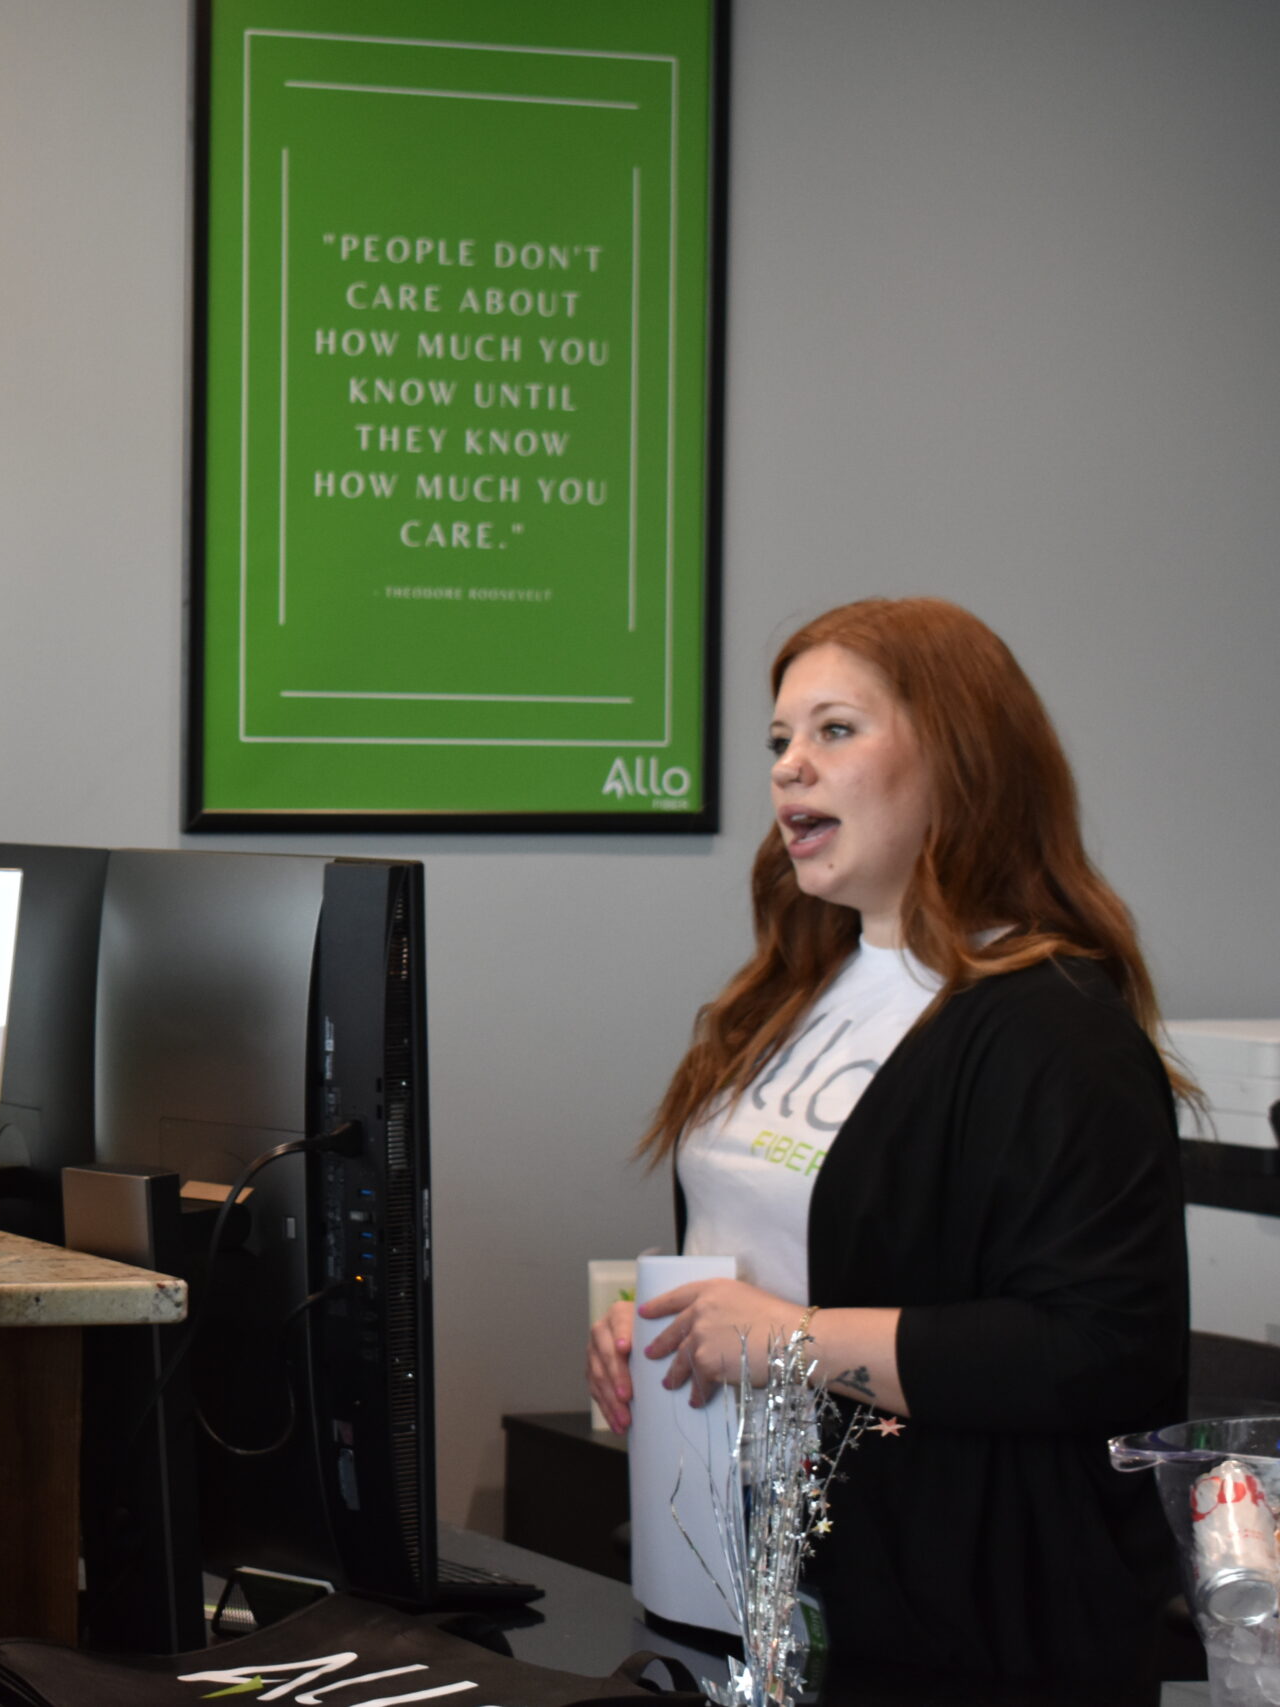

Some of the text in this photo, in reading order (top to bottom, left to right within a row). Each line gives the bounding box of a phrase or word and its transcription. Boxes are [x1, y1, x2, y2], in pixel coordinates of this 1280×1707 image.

[322, 232, 602, 273] "PEOPLE DON'T
[345, 281, 579, 318] CARE ABOUT
[314, 327, 608, 367] HOW MUCH YOU
[348, 376, 577, 412] KNOW UNTIL
[354, 423, 569, 457] THEY KNOW
[313, 470, 607, 506] HOW MUCH YOU
[399, 519, 524, 550] CARE."
[601, 756, 691, 801] Allo
[748, 1013, 881, 1132] llo
[177, 1651, 503, 1707] All
